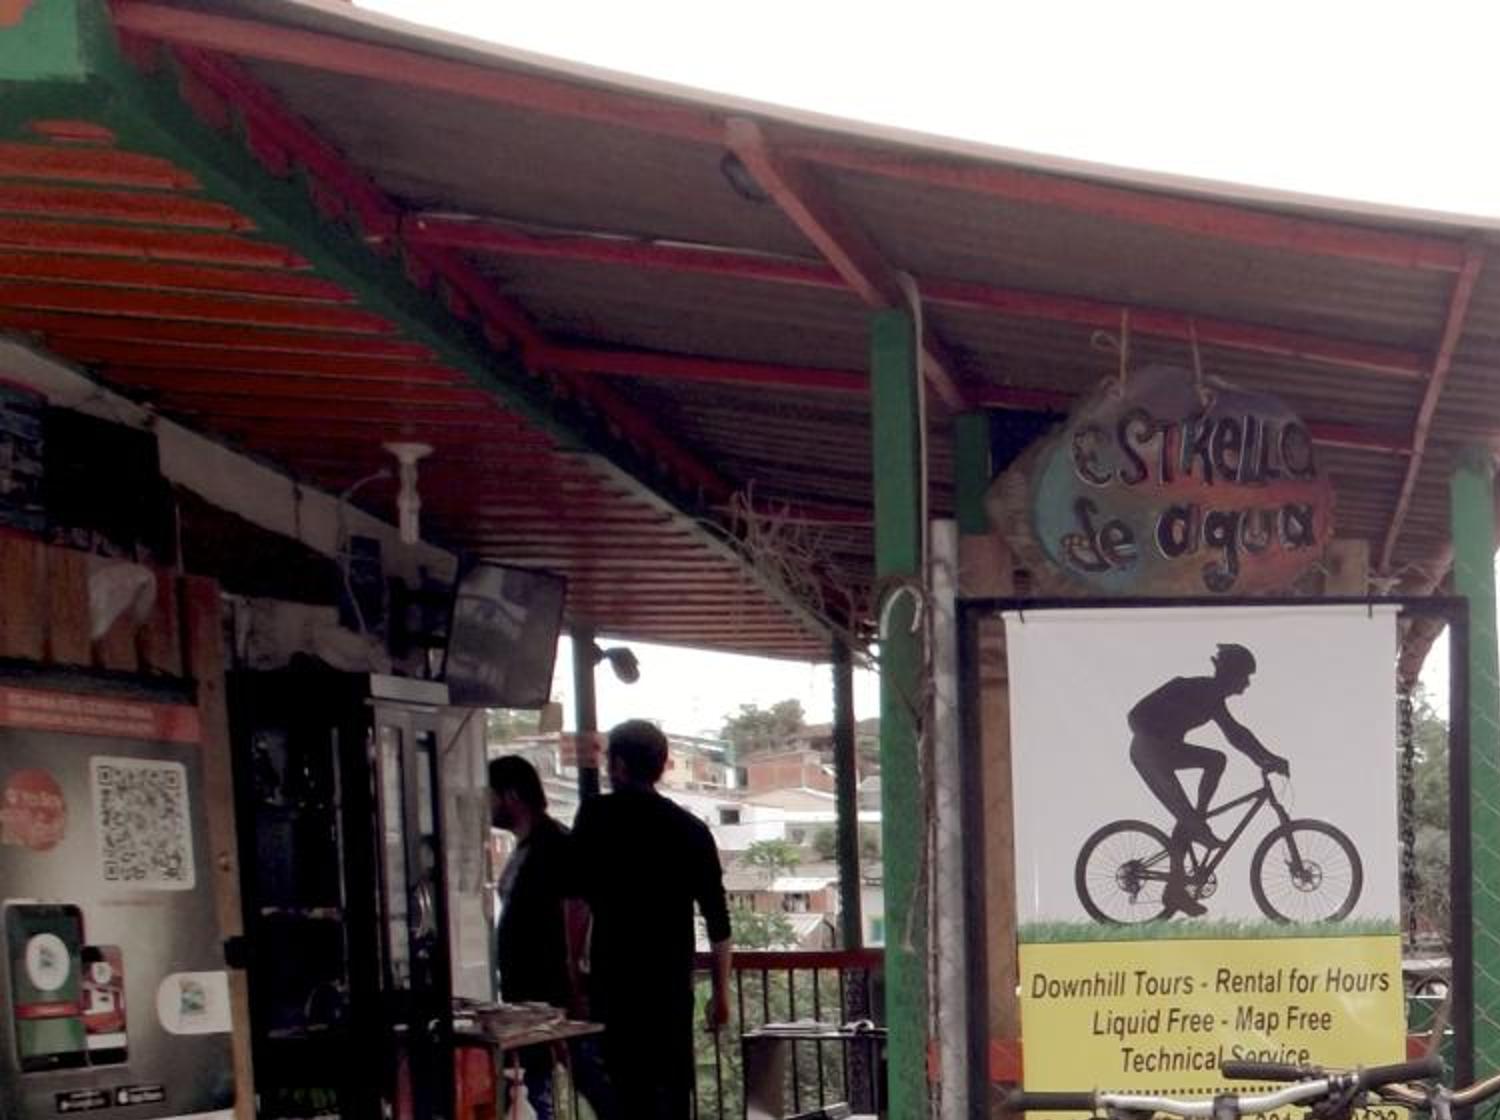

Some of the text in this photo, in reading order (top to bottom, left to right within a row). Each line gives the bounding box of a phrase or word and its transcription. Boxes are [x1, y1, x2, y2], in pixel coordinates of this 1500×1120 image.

[1061, 497, 1317, 592] de agua
[1031, 970, 1126, 999] Downhill
[1133, 971, 1194, 996] Tours
[1215, 967, 1282, 993] Rental
[1288, 967, 1318, 993] for
[1325, 966, 1390, 992] Hours
[1092, 1009, 1161, 1040] Liquid
[1167, 1008, 1215, 1033] Free
[1235, 1005, 1280, 1036] Map
[1286, 1005, 1332, 1031] Free
[1121, 1045, 1224, 1073] Technical
